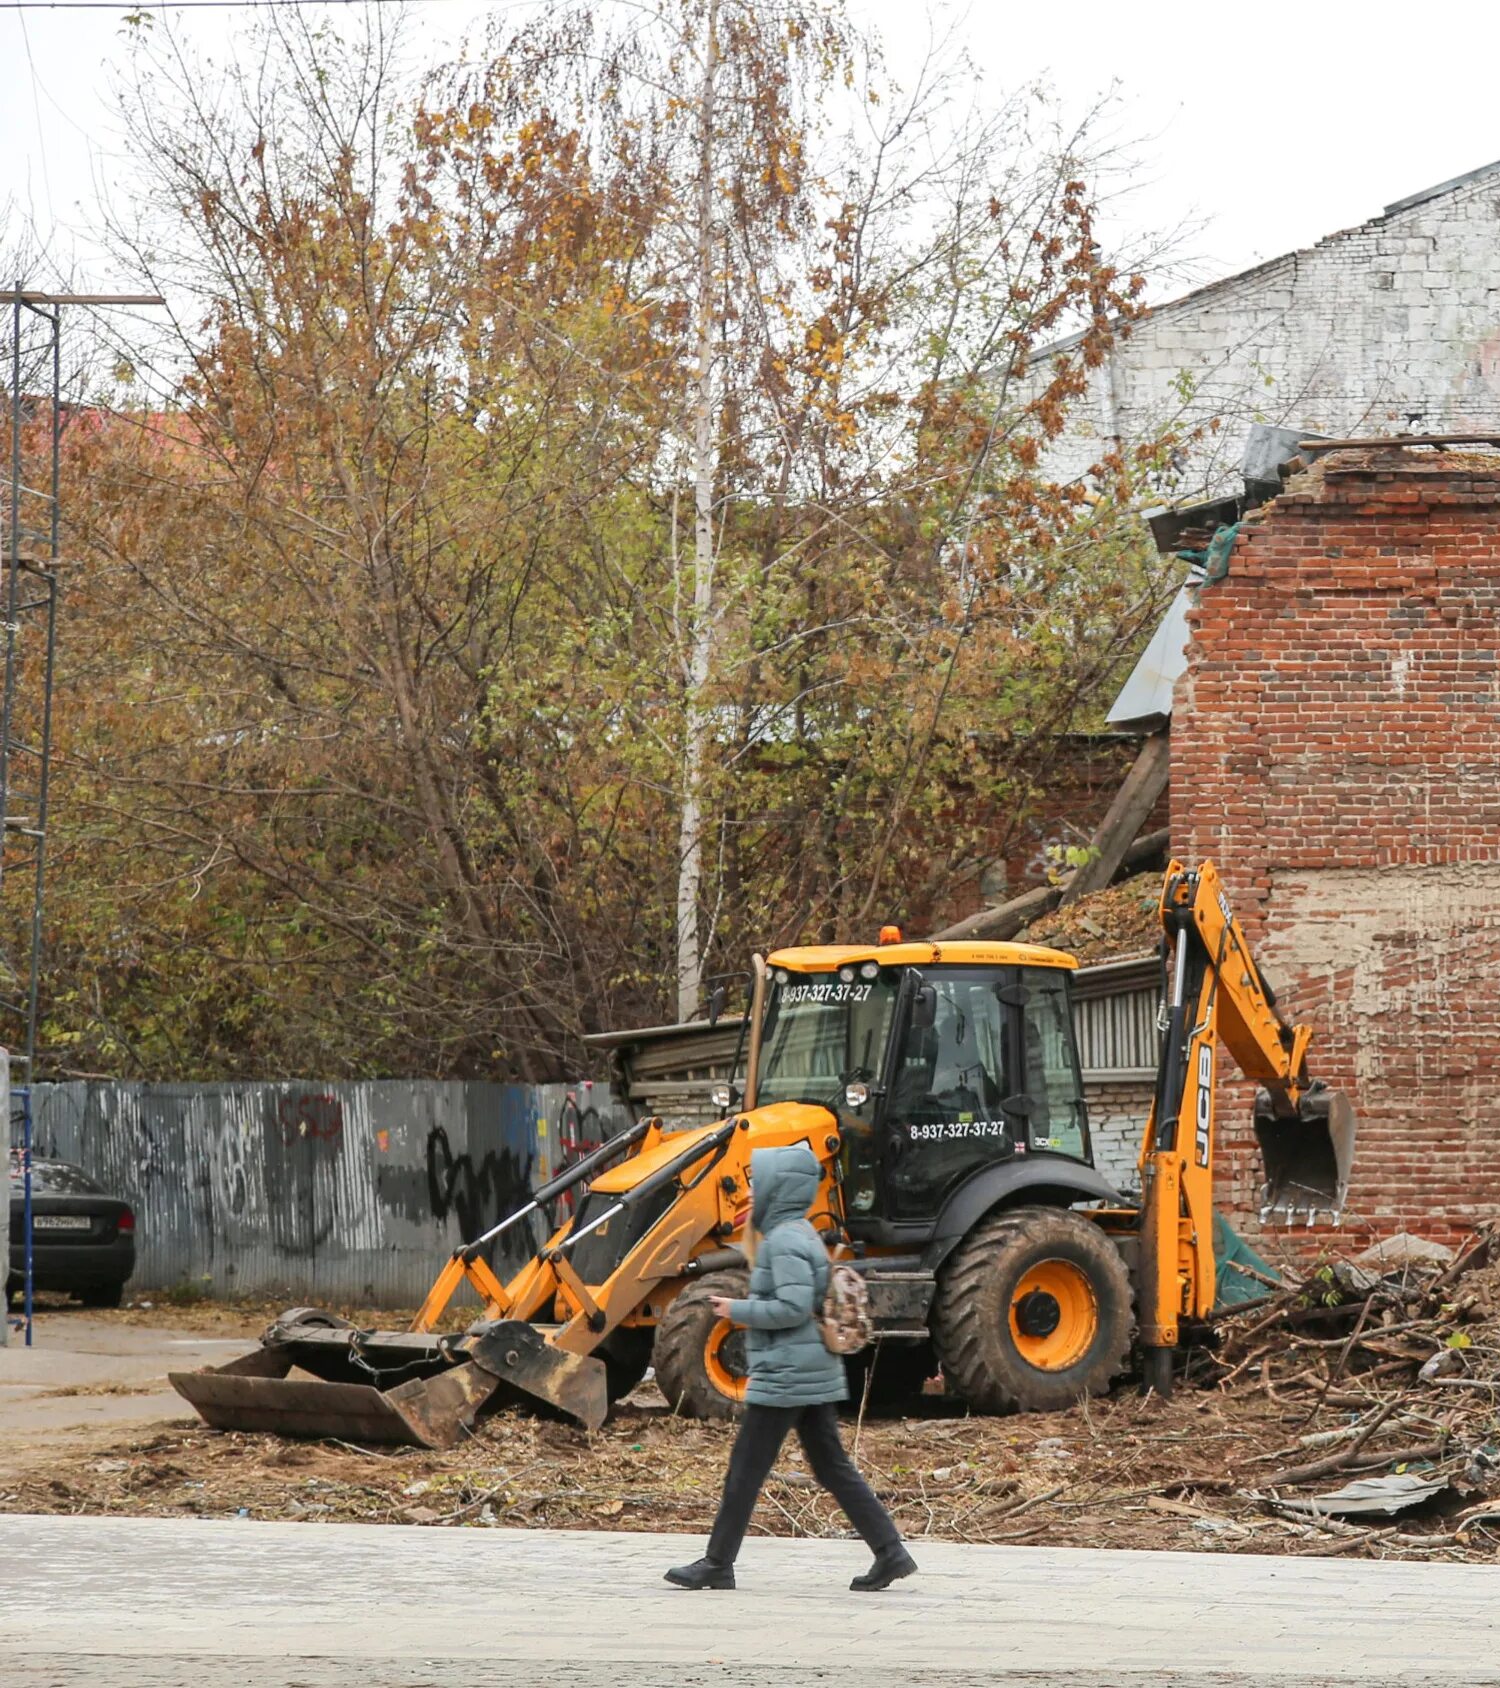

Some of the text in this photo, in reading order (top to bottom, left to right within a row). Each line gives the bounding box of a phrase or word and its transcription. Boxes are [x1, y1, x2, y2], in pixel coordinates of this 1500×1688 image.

[781, 984, 873, 1004] 8-937-327-37-27
[1196, 1045, 1212, 1167] JCB
[910, 1121, 1004, 1140] 8-937-327-37-27
